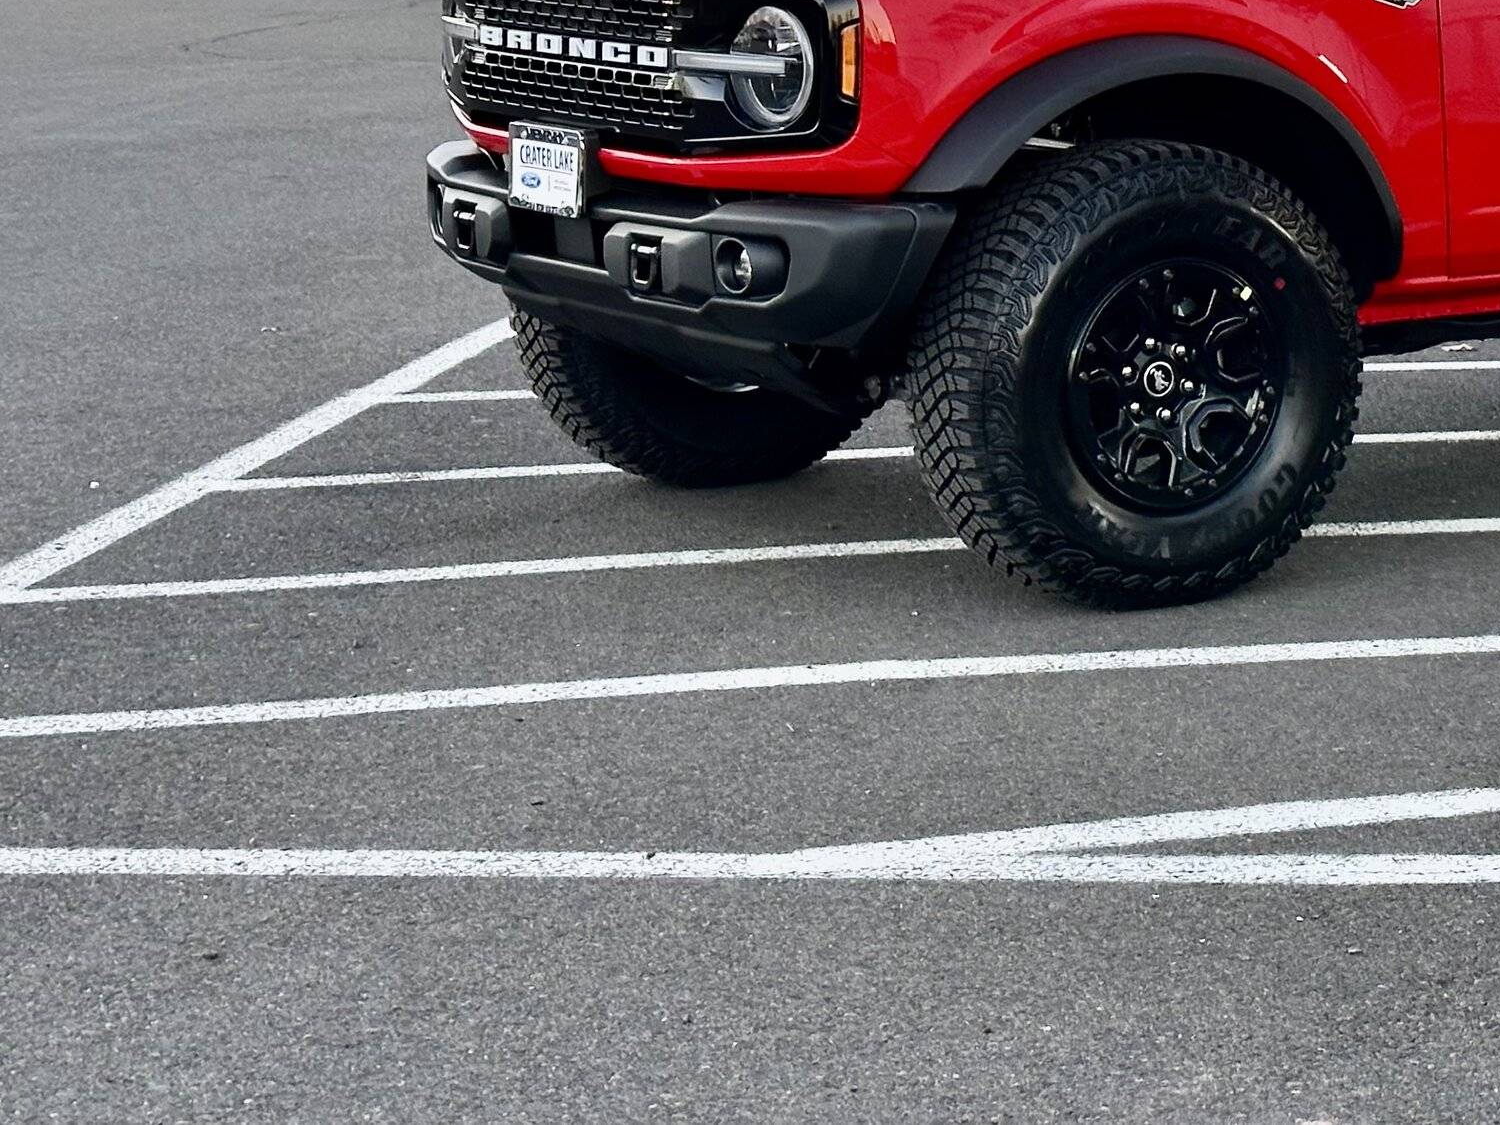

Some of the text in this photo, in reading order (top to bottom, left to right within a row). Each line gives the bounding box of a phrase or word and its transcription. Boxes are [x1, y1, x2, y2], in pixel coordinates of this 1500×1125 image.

[479, 25, 668, 68] BRONCO
[520, 144, 574, 172] CRATER LAKE
